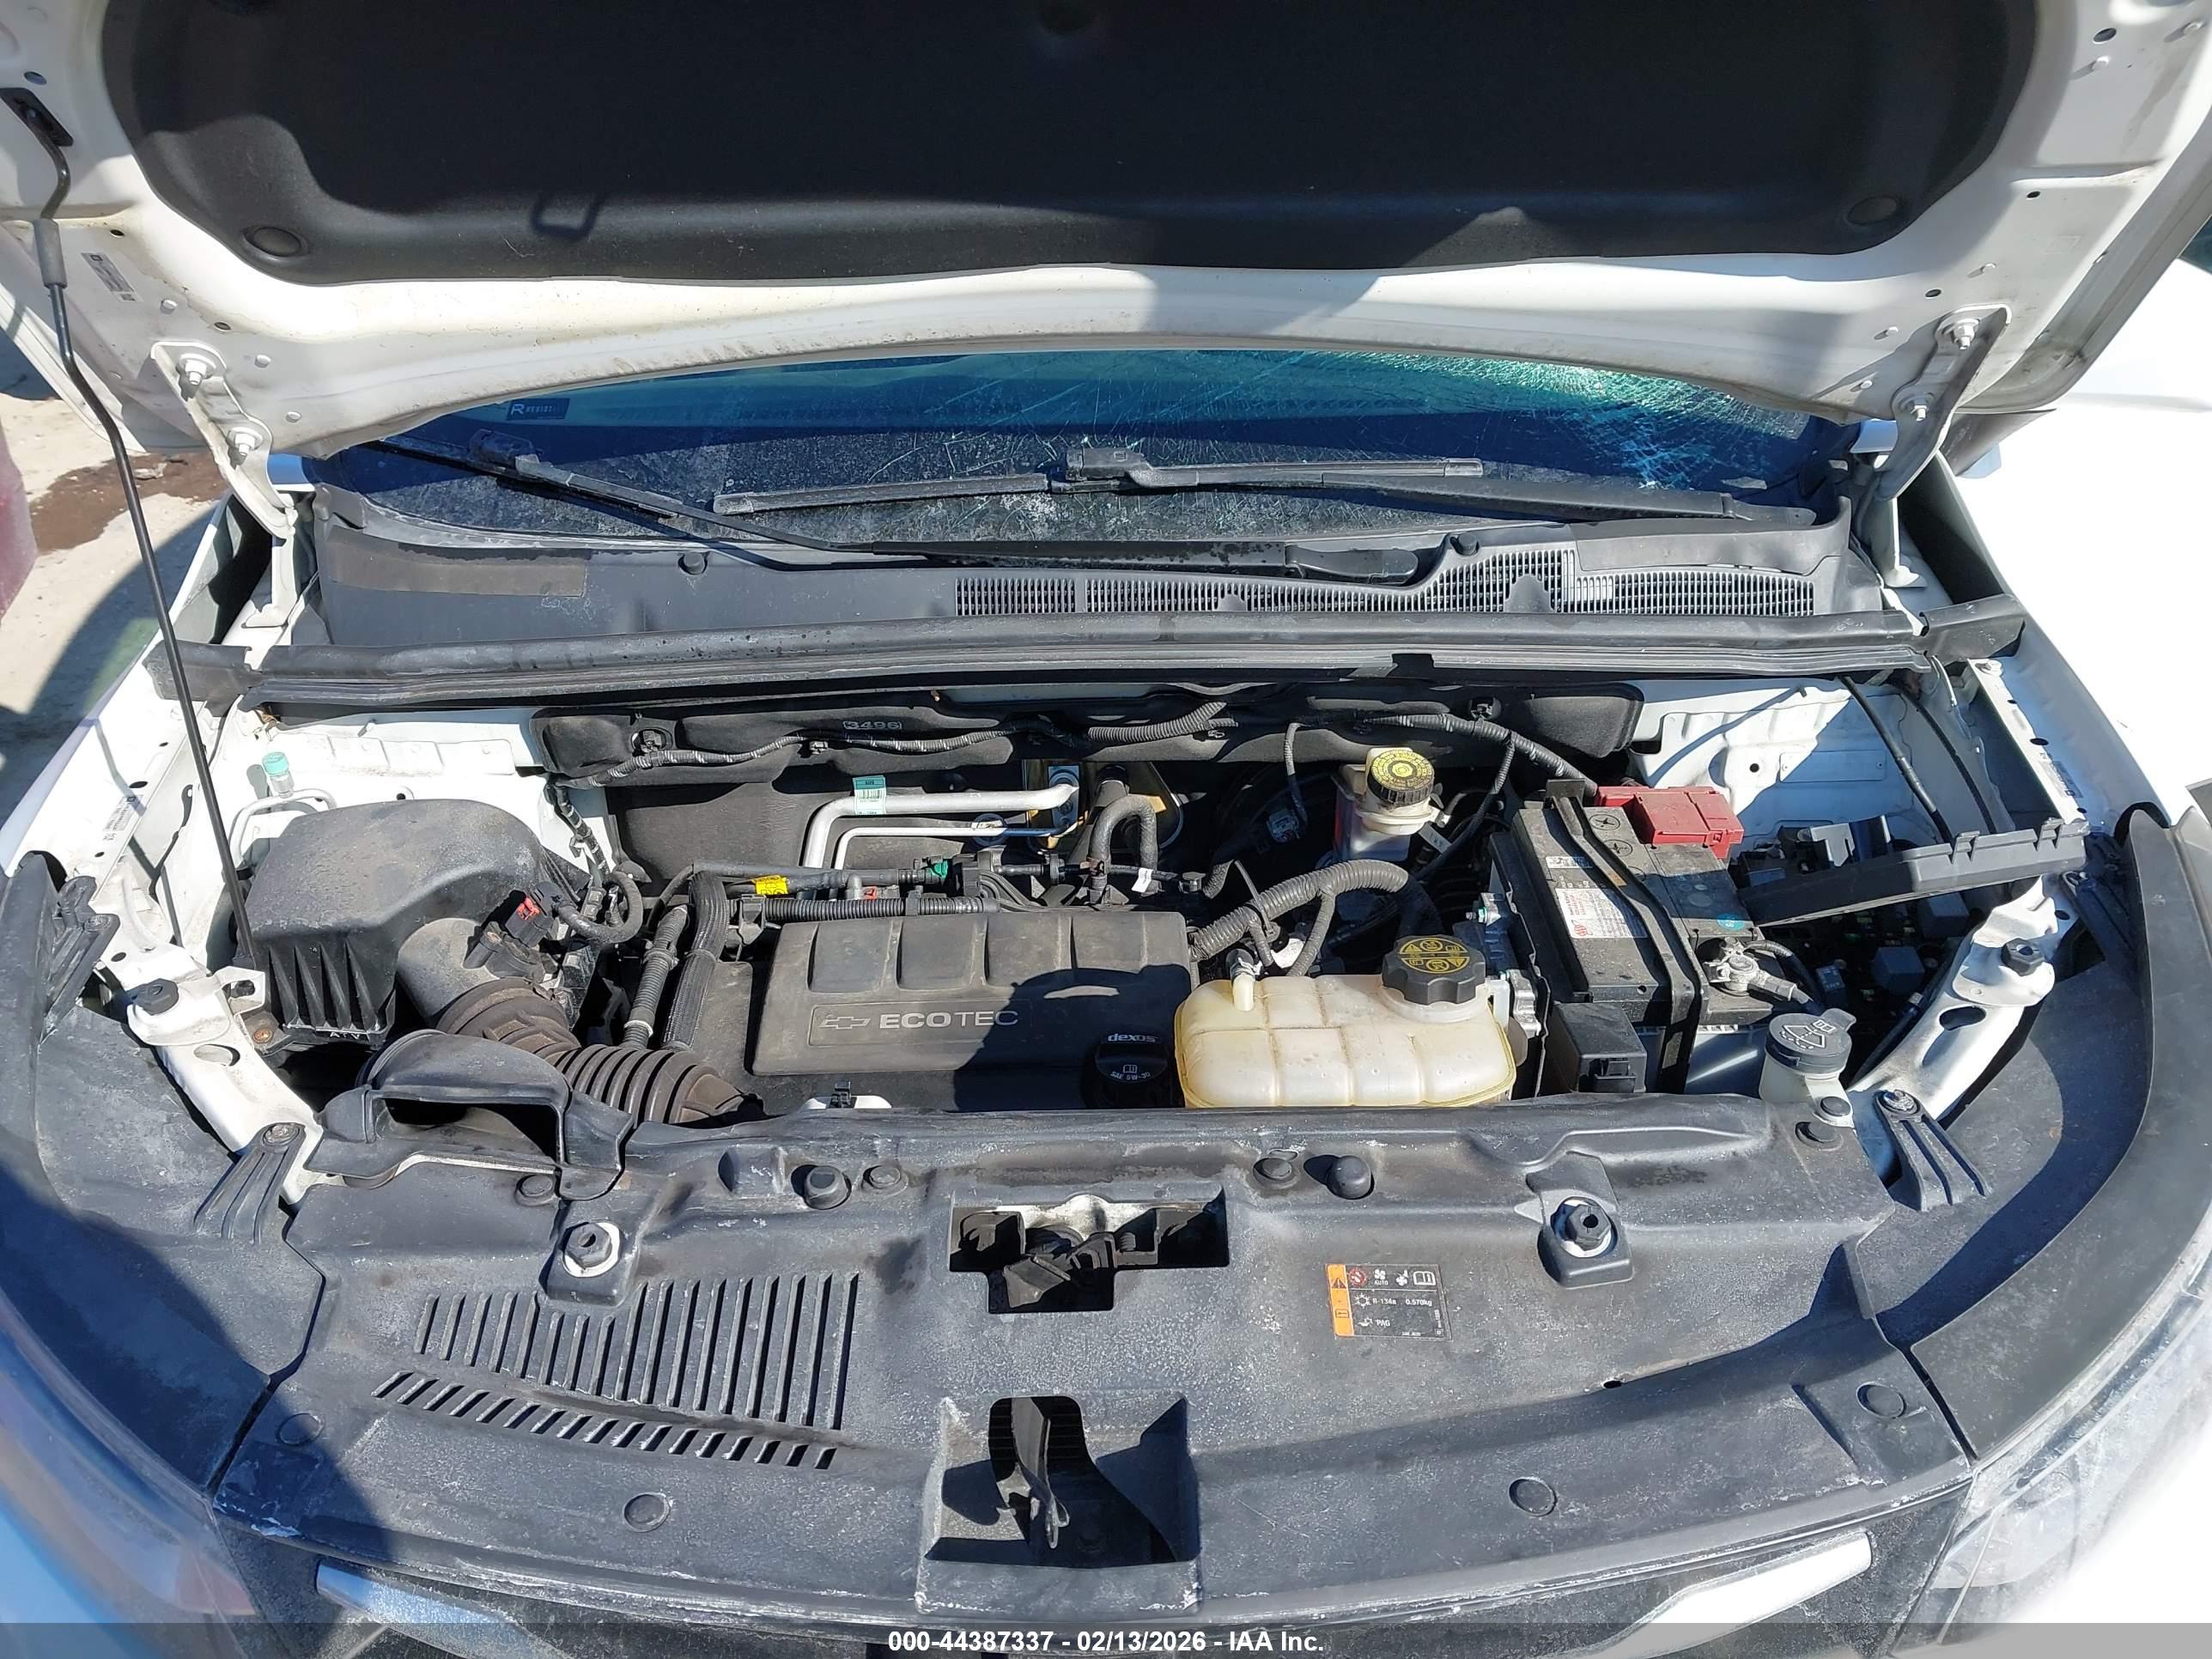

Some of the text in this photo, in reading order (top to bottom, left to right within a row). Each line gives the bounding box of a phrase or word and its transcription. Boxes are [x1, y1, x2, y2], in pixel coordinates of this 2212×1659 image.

[879, 1011, 1018, 1029] ECOTEC
[1108, 1033, 1158, 1042] dexos
[1405, 1298, 1432, 1307] 0.570kg
